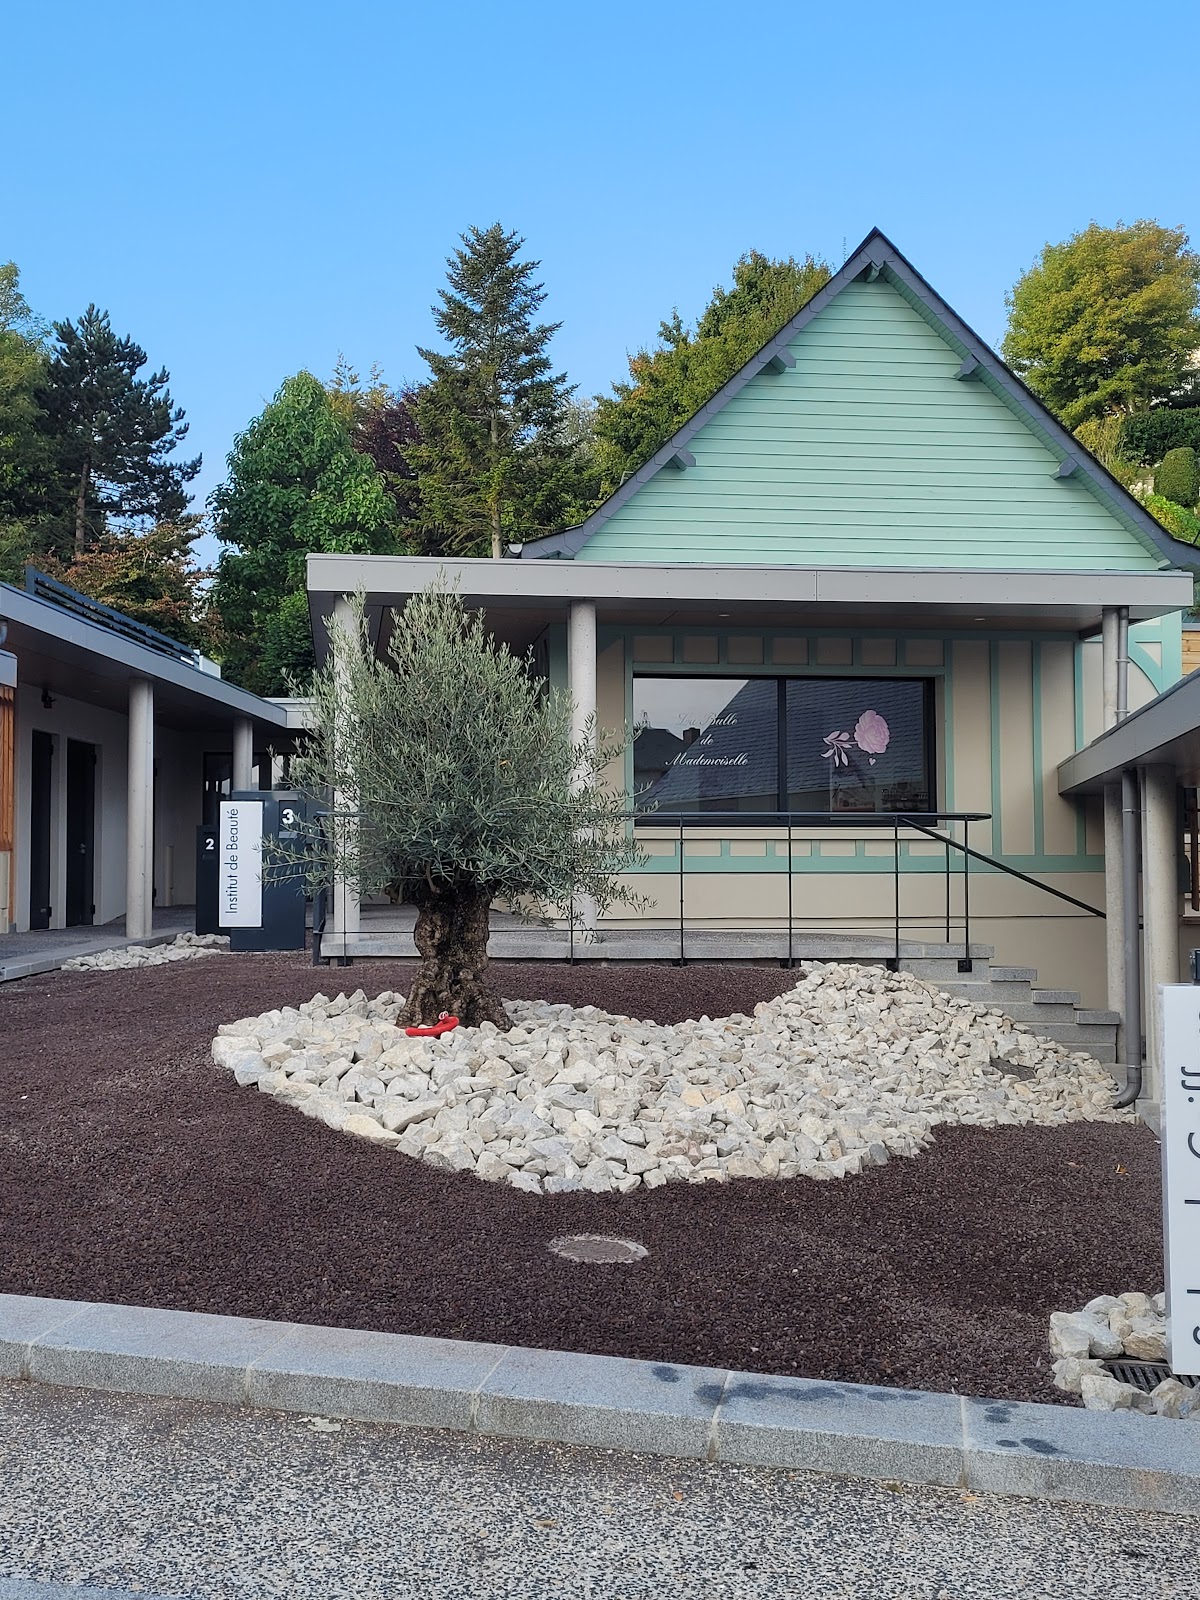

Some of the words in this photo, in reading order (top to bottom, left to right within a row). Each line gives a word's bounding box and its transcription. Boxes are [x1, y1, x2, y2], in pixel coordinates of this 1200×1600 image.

[679, 712, 697, 726] La
[700, 712, 738, 726] Bulle
[700, 734, 714, 745] de
[665, 752, 749, 766] Mademoiselle
[282, 809, 294, 824] 3
[225, 808, 239, 850] Beauté
[205, 838, 215, 850] 2
[224, 854, 238, 870] de
[225, 874, 238, 914] Institut
